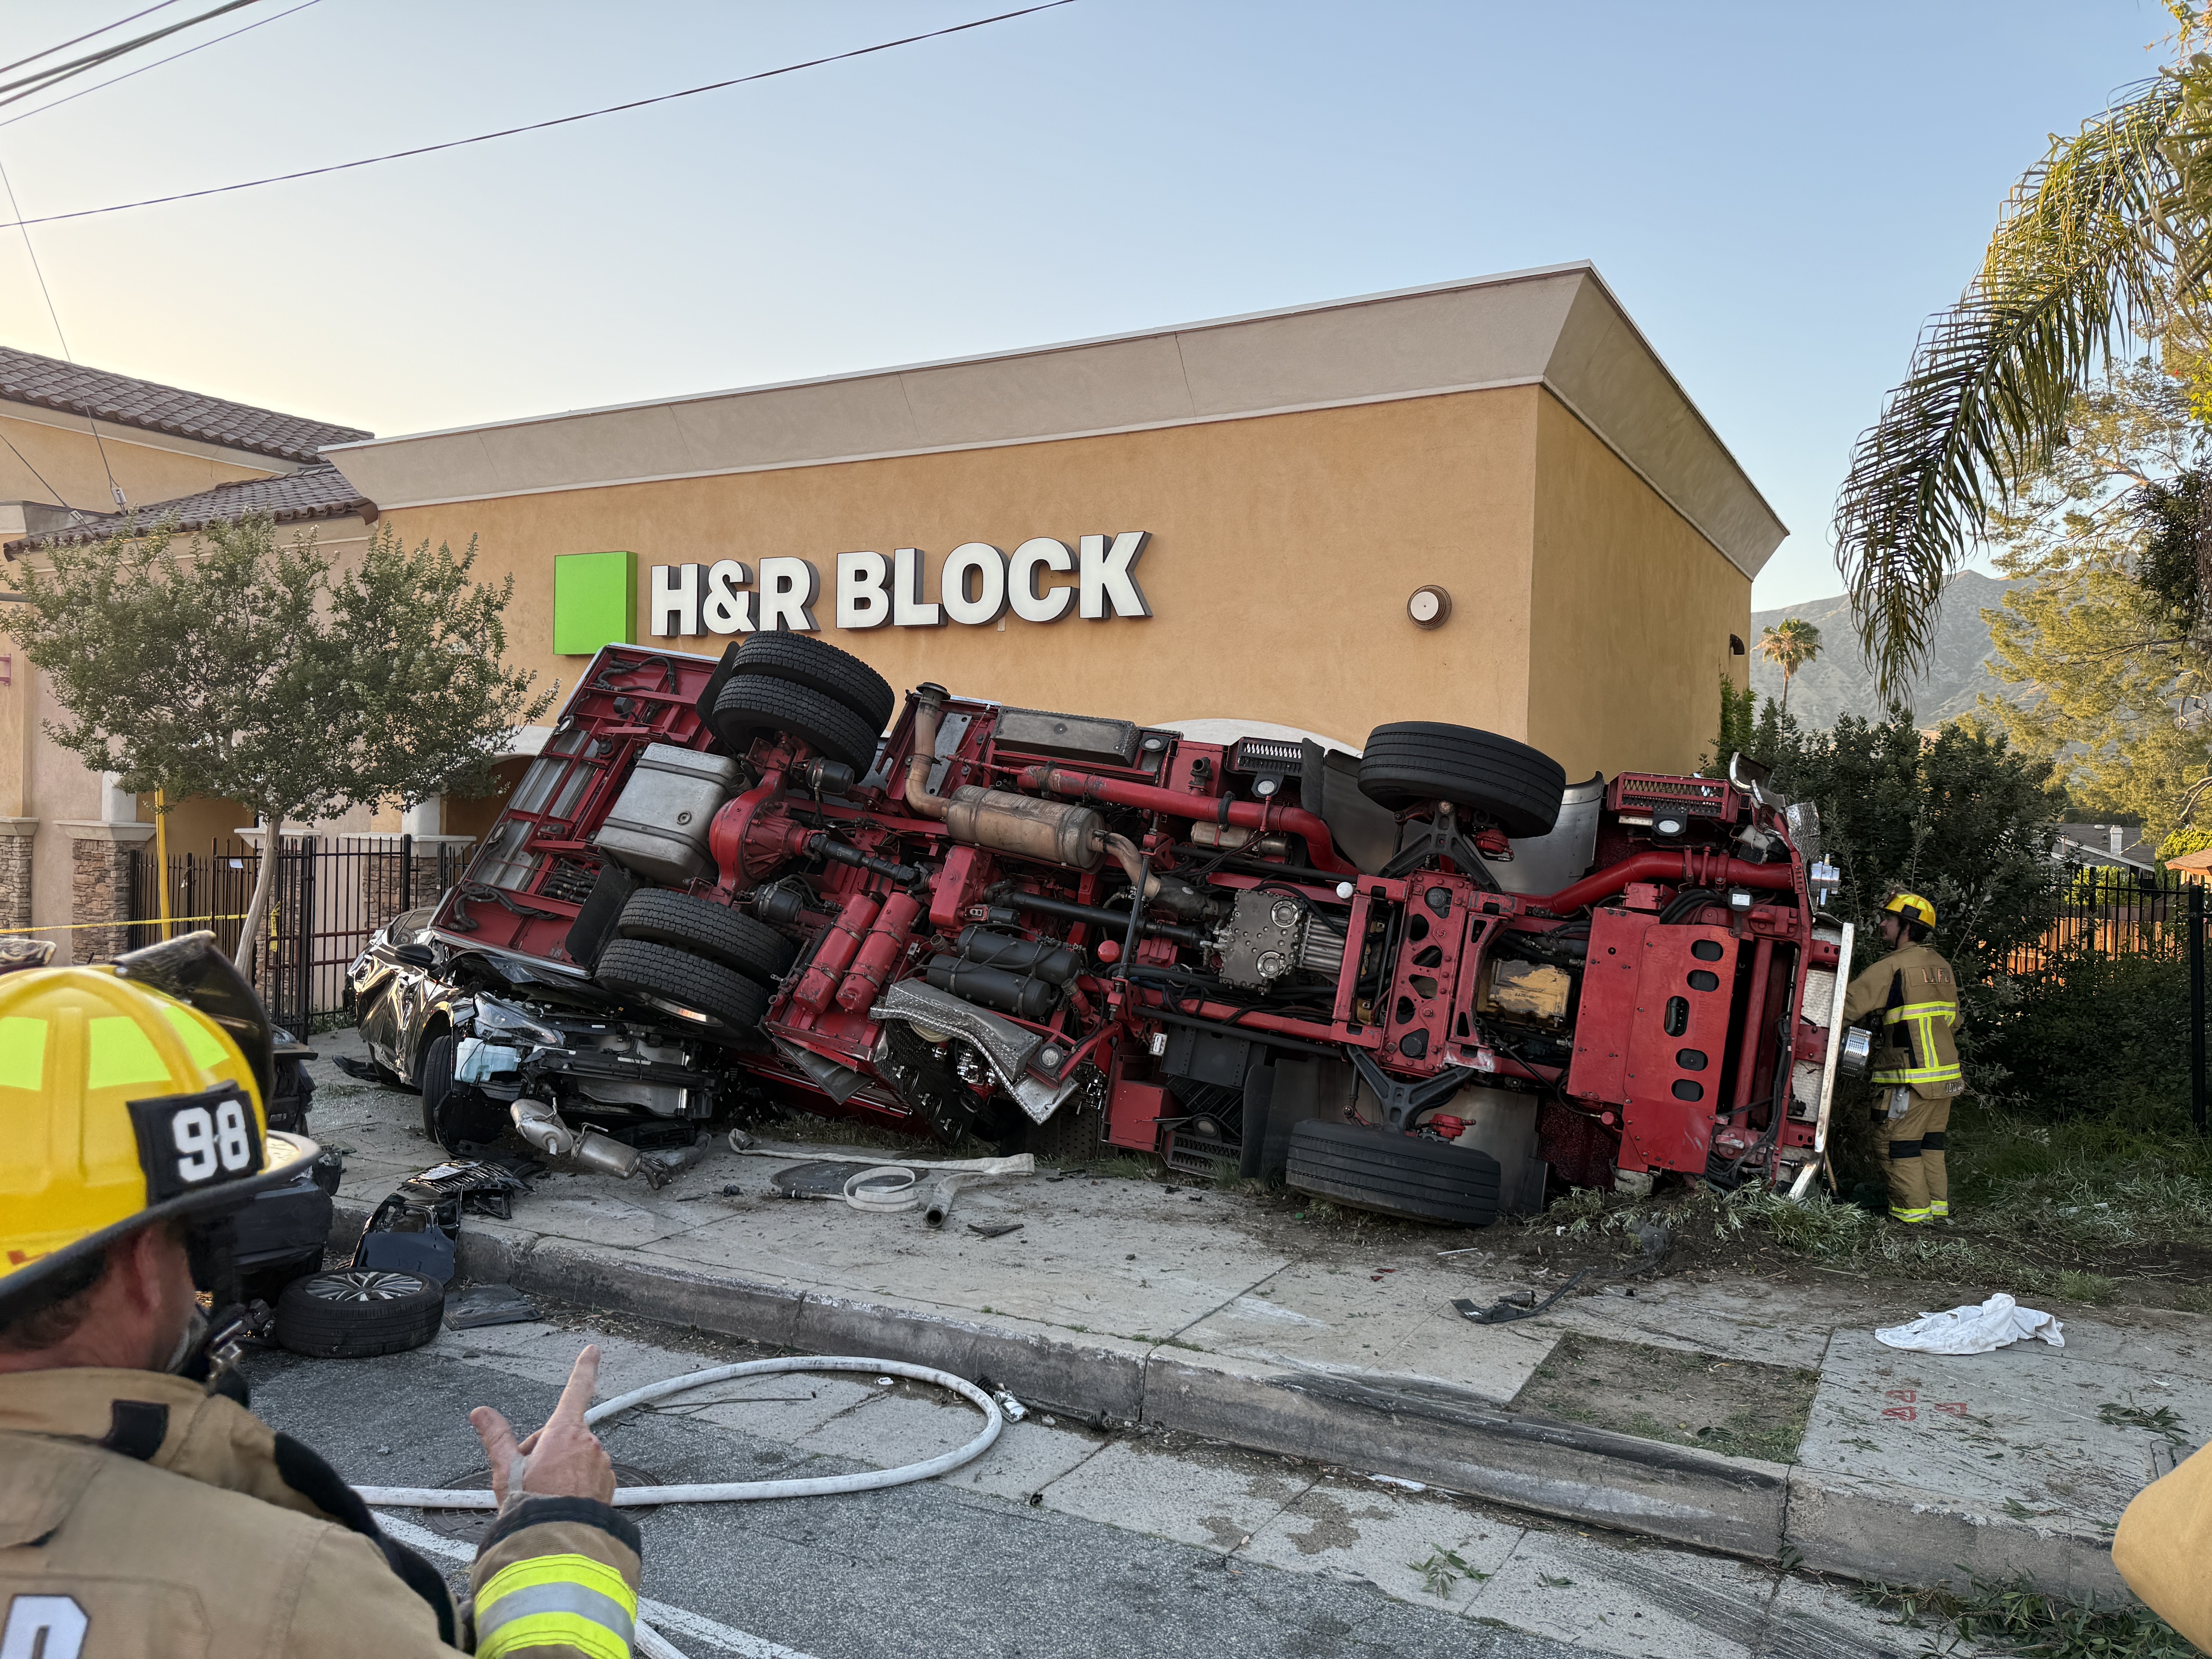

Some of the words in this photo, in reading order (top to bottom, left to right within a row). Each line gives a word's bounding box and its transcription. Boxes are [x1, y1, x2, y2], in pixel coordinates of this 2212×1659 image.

[651, 557, 820, 636] H&R
[836, 531, 1153, 629] BLOCK
[172, 1099, 251, 1182] 98
